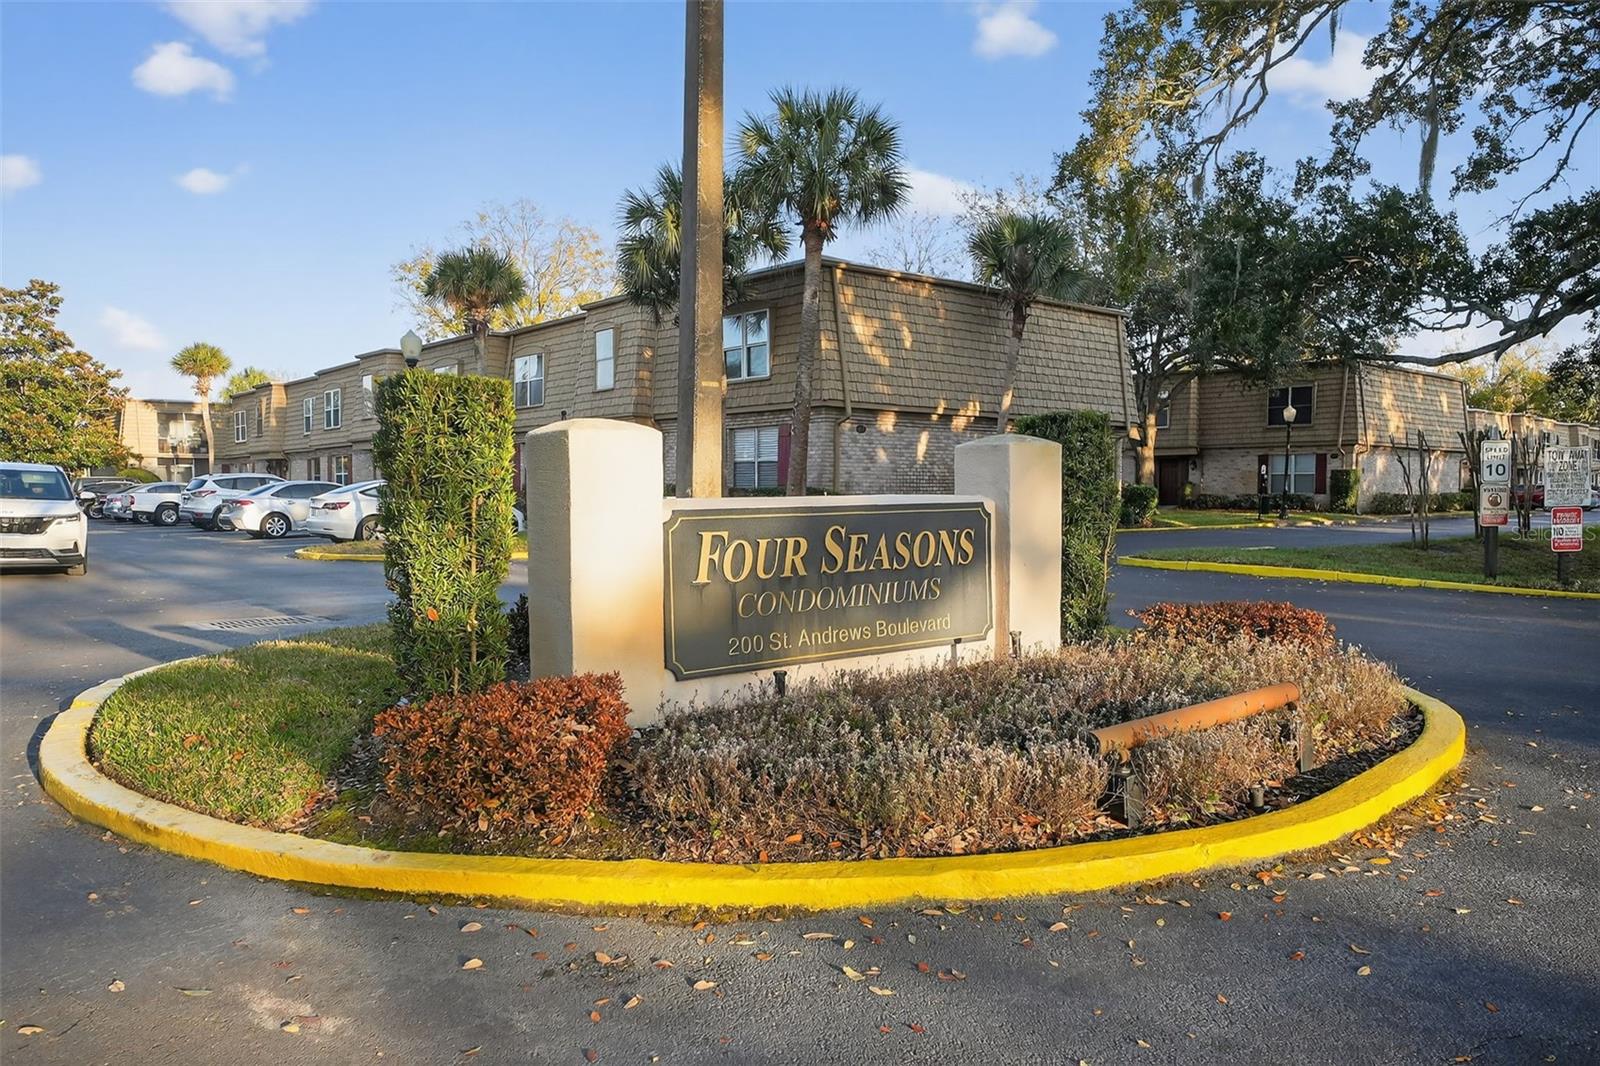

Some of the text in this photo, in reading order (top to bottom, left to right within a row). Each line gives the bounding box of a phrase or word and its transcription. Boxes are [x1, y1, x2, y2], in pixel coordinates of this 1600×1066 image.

[1548, 450, 1565, 461] TOW
[1486, 463, 1506, 476] 10
[1559, 460, 1577, 471] ZONE
[1553, 527, 1564, 536] NO
[692, 525, 976, 585] FOUR SEASONS
[737, 577, 942, 618] CONDOMINIUMS
[728, 613, 951, 656] 200 St. Andrews Boulevard
